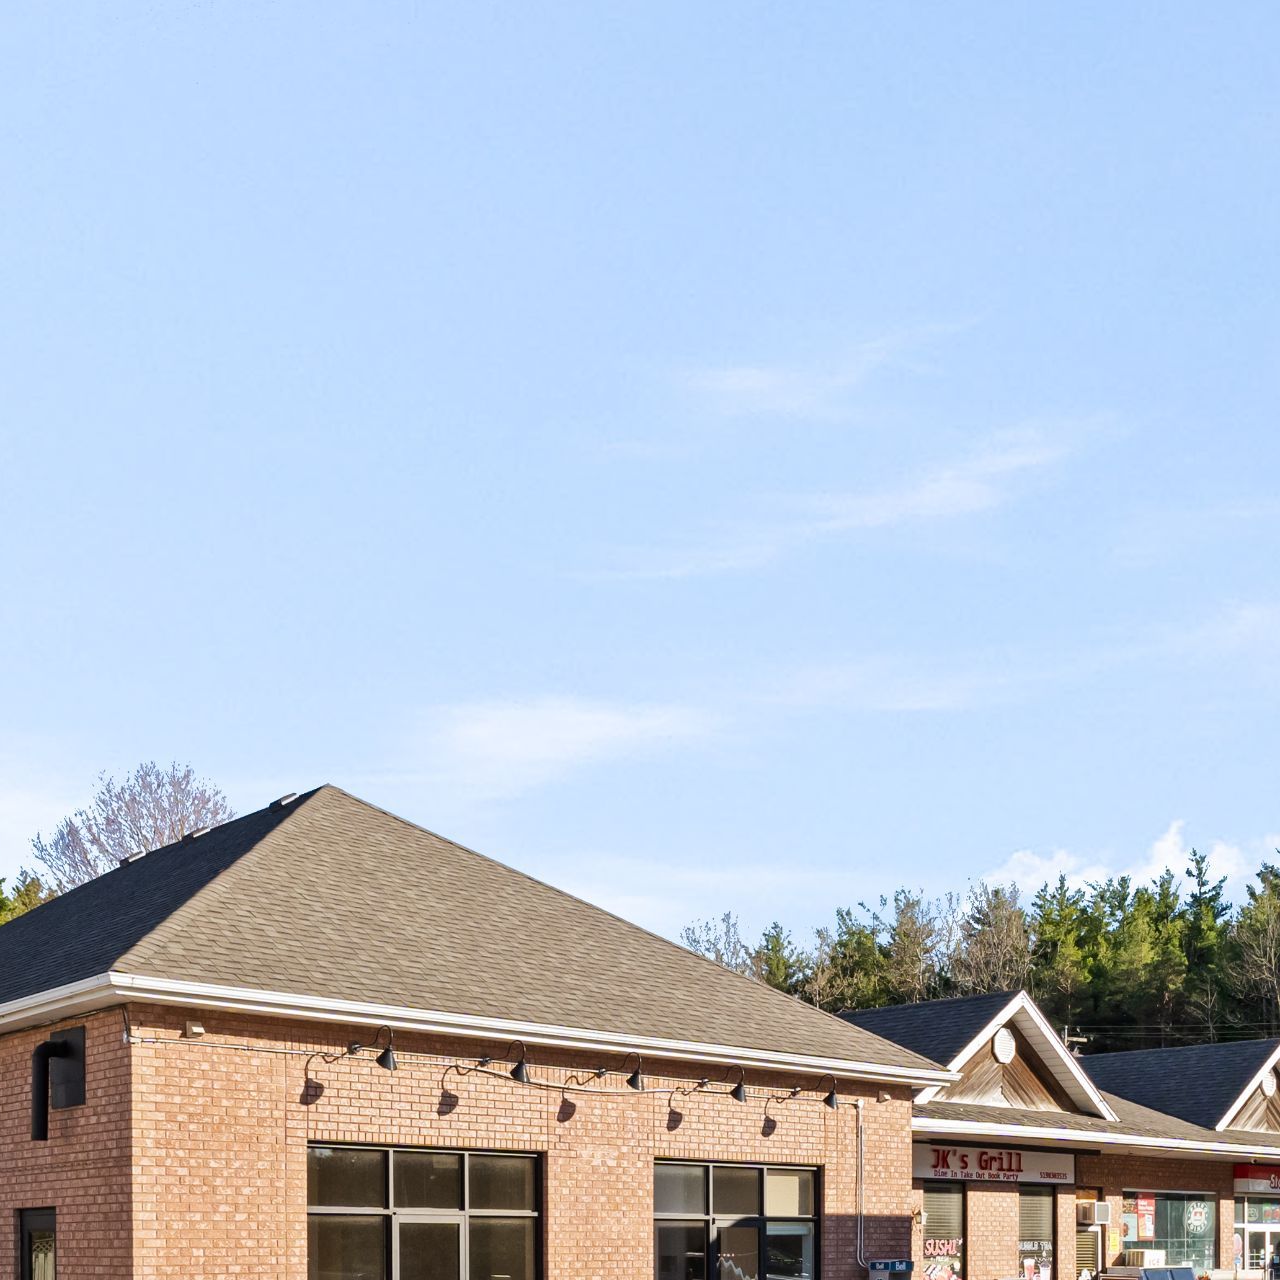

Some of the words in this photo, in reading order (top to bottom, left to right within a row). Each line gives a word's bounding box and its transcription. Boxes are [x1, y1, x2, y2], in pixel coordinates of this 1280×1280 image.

[931, 1148, 969, 1170] JK's
[978, 1151, 1024, 1173] Grill
[933, 1169, 948, 1178] Dine
[950, 1170, 958, 1178] In
[960, 1171, 973, 1179] Take
[975, 1171, 986, 1179] Out
[987, 1172, 1001, 1180] Book
[1002, 1172, 1019, 1181] Party
[924, 1238, 958, 1256] SUSHI
[895, 1261, 907, 1271] Bell
